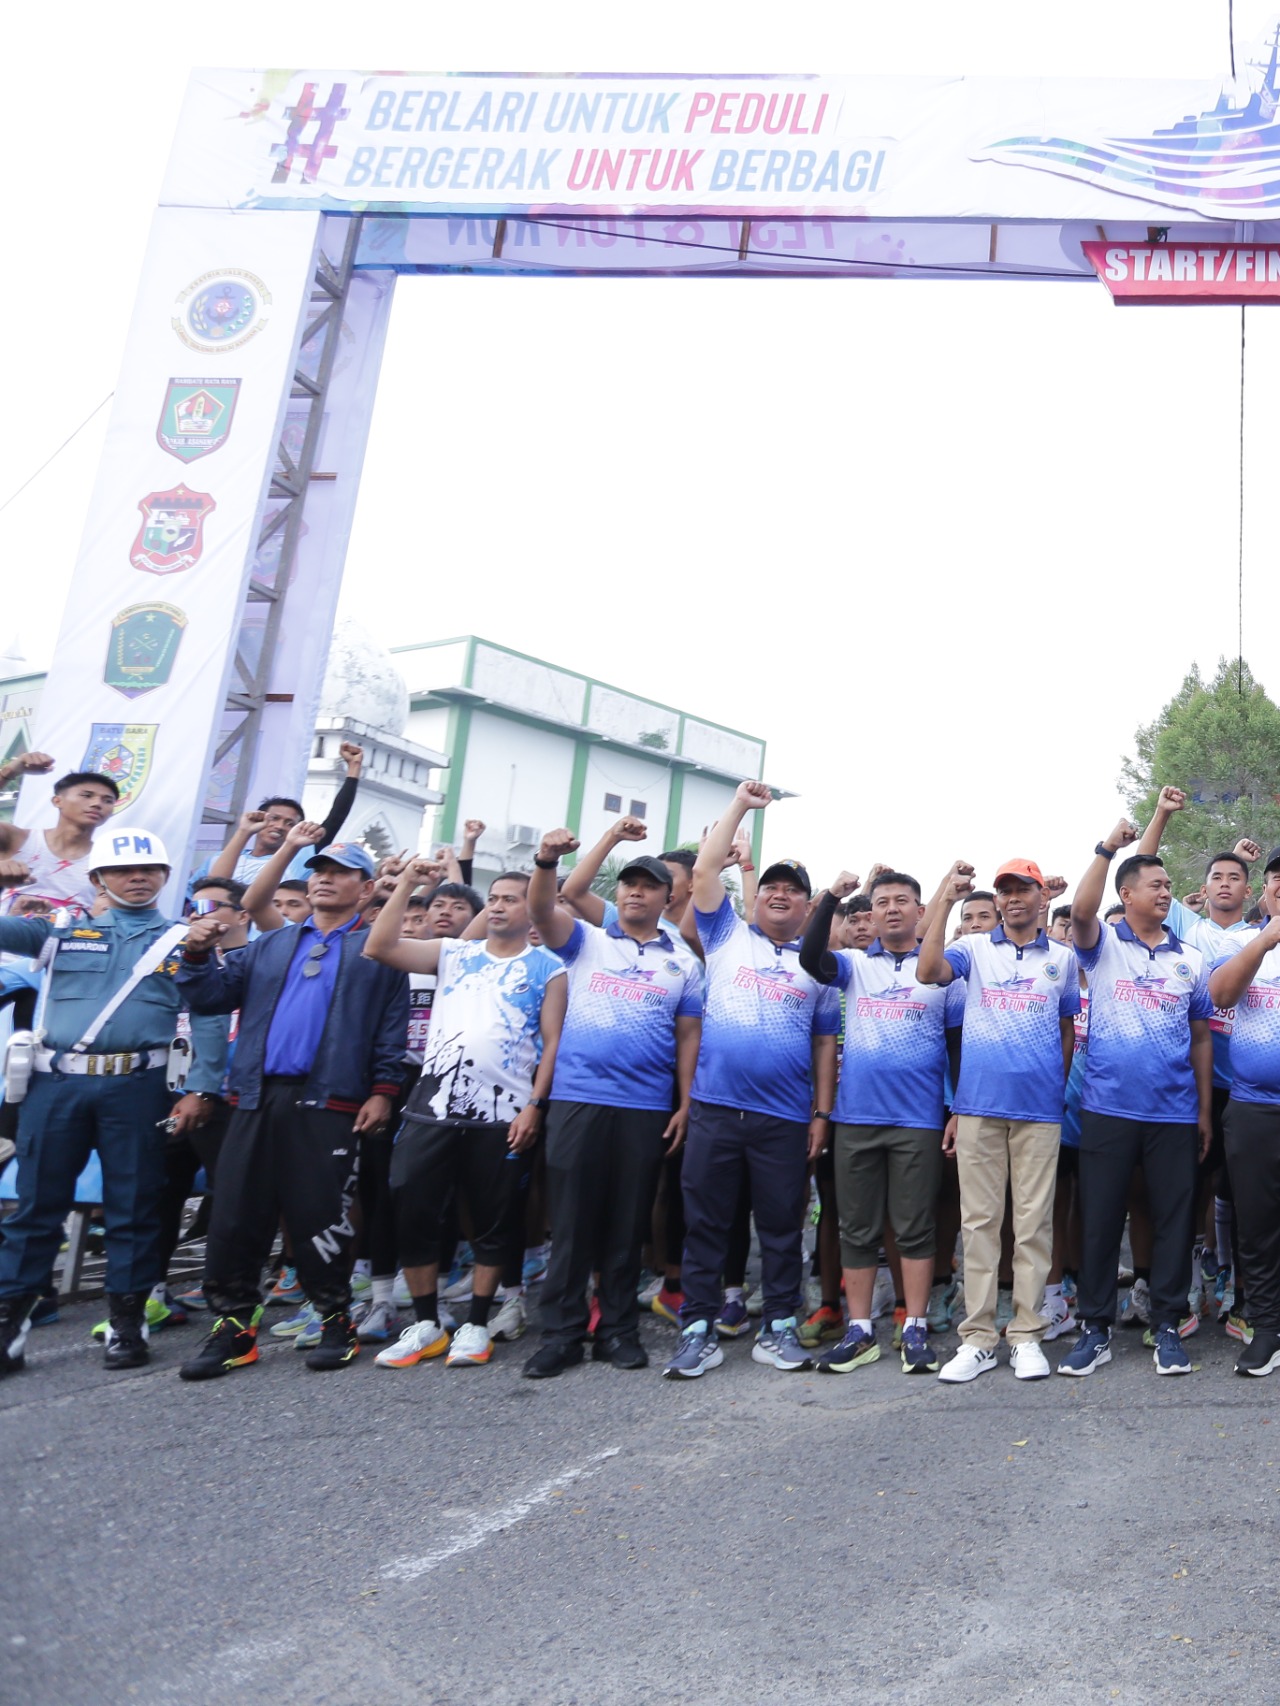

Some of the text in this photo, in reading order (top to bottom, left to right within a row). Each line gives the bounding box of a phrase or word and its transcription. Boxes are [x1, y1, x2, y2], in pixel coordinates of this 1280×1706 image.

[365, 91, 829, 135] BERLARI UNTUK PEDULI
[345, 147, 885, 193] BERGERAK UNTUK BERBAGI
[112, 836, 152, 856] PM
[621, 988, 644, 1002] FUN
[643, 993, 665, 1007] RUN
[762, 986, 784, 1002] FUN
[783, 994, 804, 1010] RUN
[1113, 988, 1136, 1002] FEST
[1247, 994, 1265, 1008] FEST
[1265, 996, 1275, 1009] &
[885, 1008, 904, 1020] FUN
[905, 1009, 925, 1021] RUN
[998, 997, 1007, 1010] &
[1008, 999, 1026, 1012] FUN
[1027, 1000, 1045, 1014] RUN
